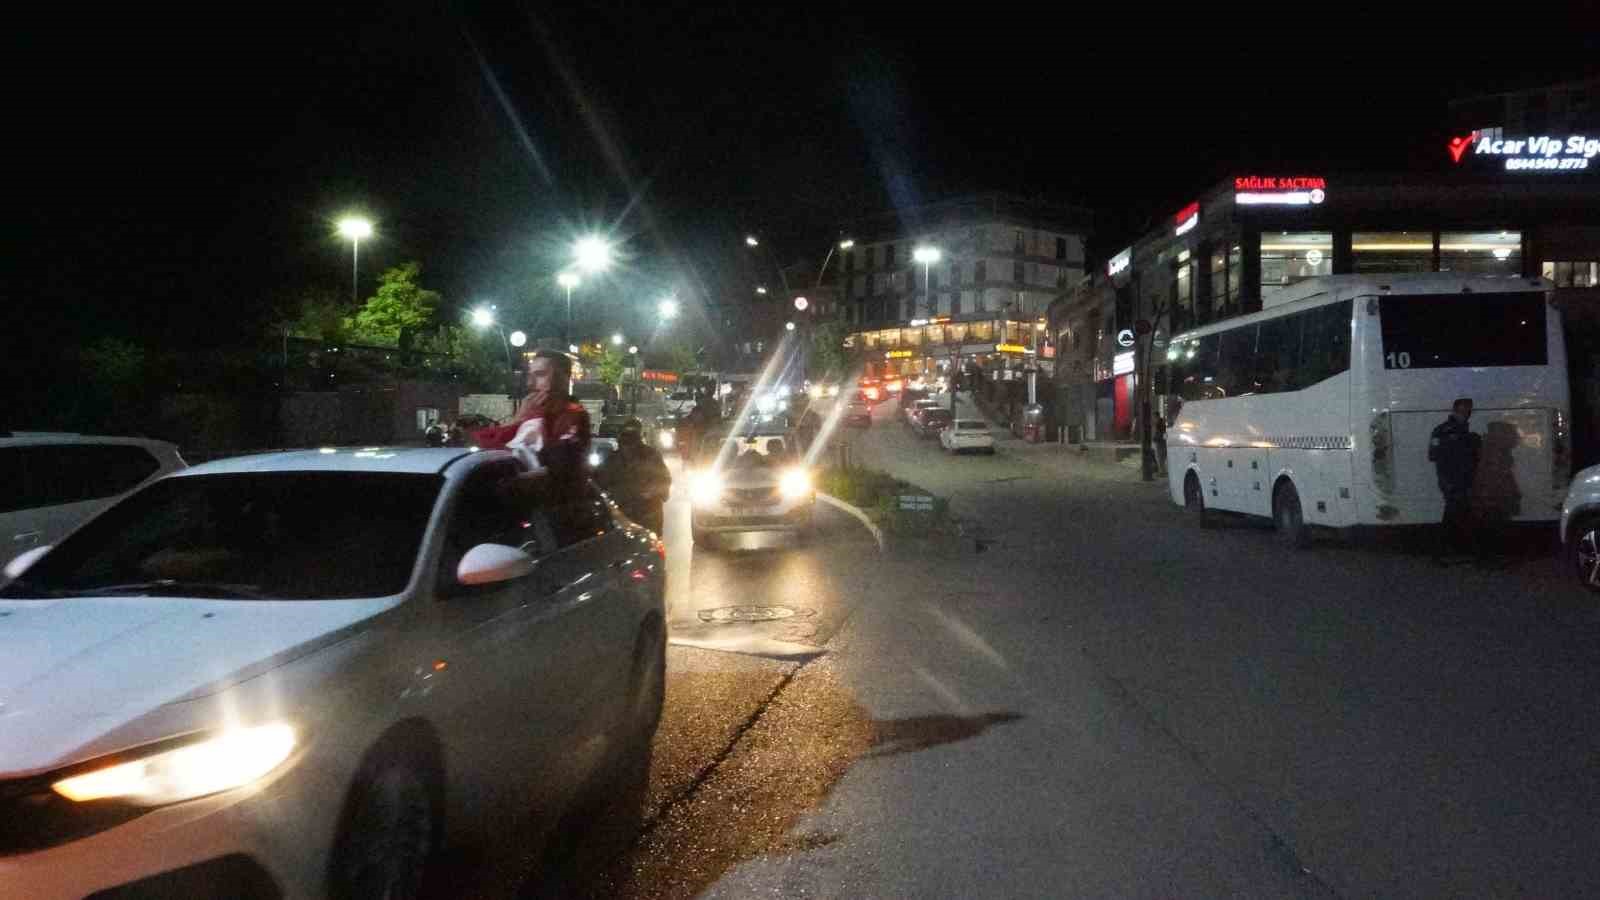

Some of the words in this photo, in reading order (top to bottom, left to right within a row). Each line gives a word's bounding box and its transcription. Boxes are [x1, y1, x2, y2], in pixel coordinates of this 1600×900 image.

[1475, 137, 1526, 154] Acar
[1528, 136, 1563, 157] Vip
[1565, 136, 1600, 158] Sig
[1386, 351, 1411, 369] 10
